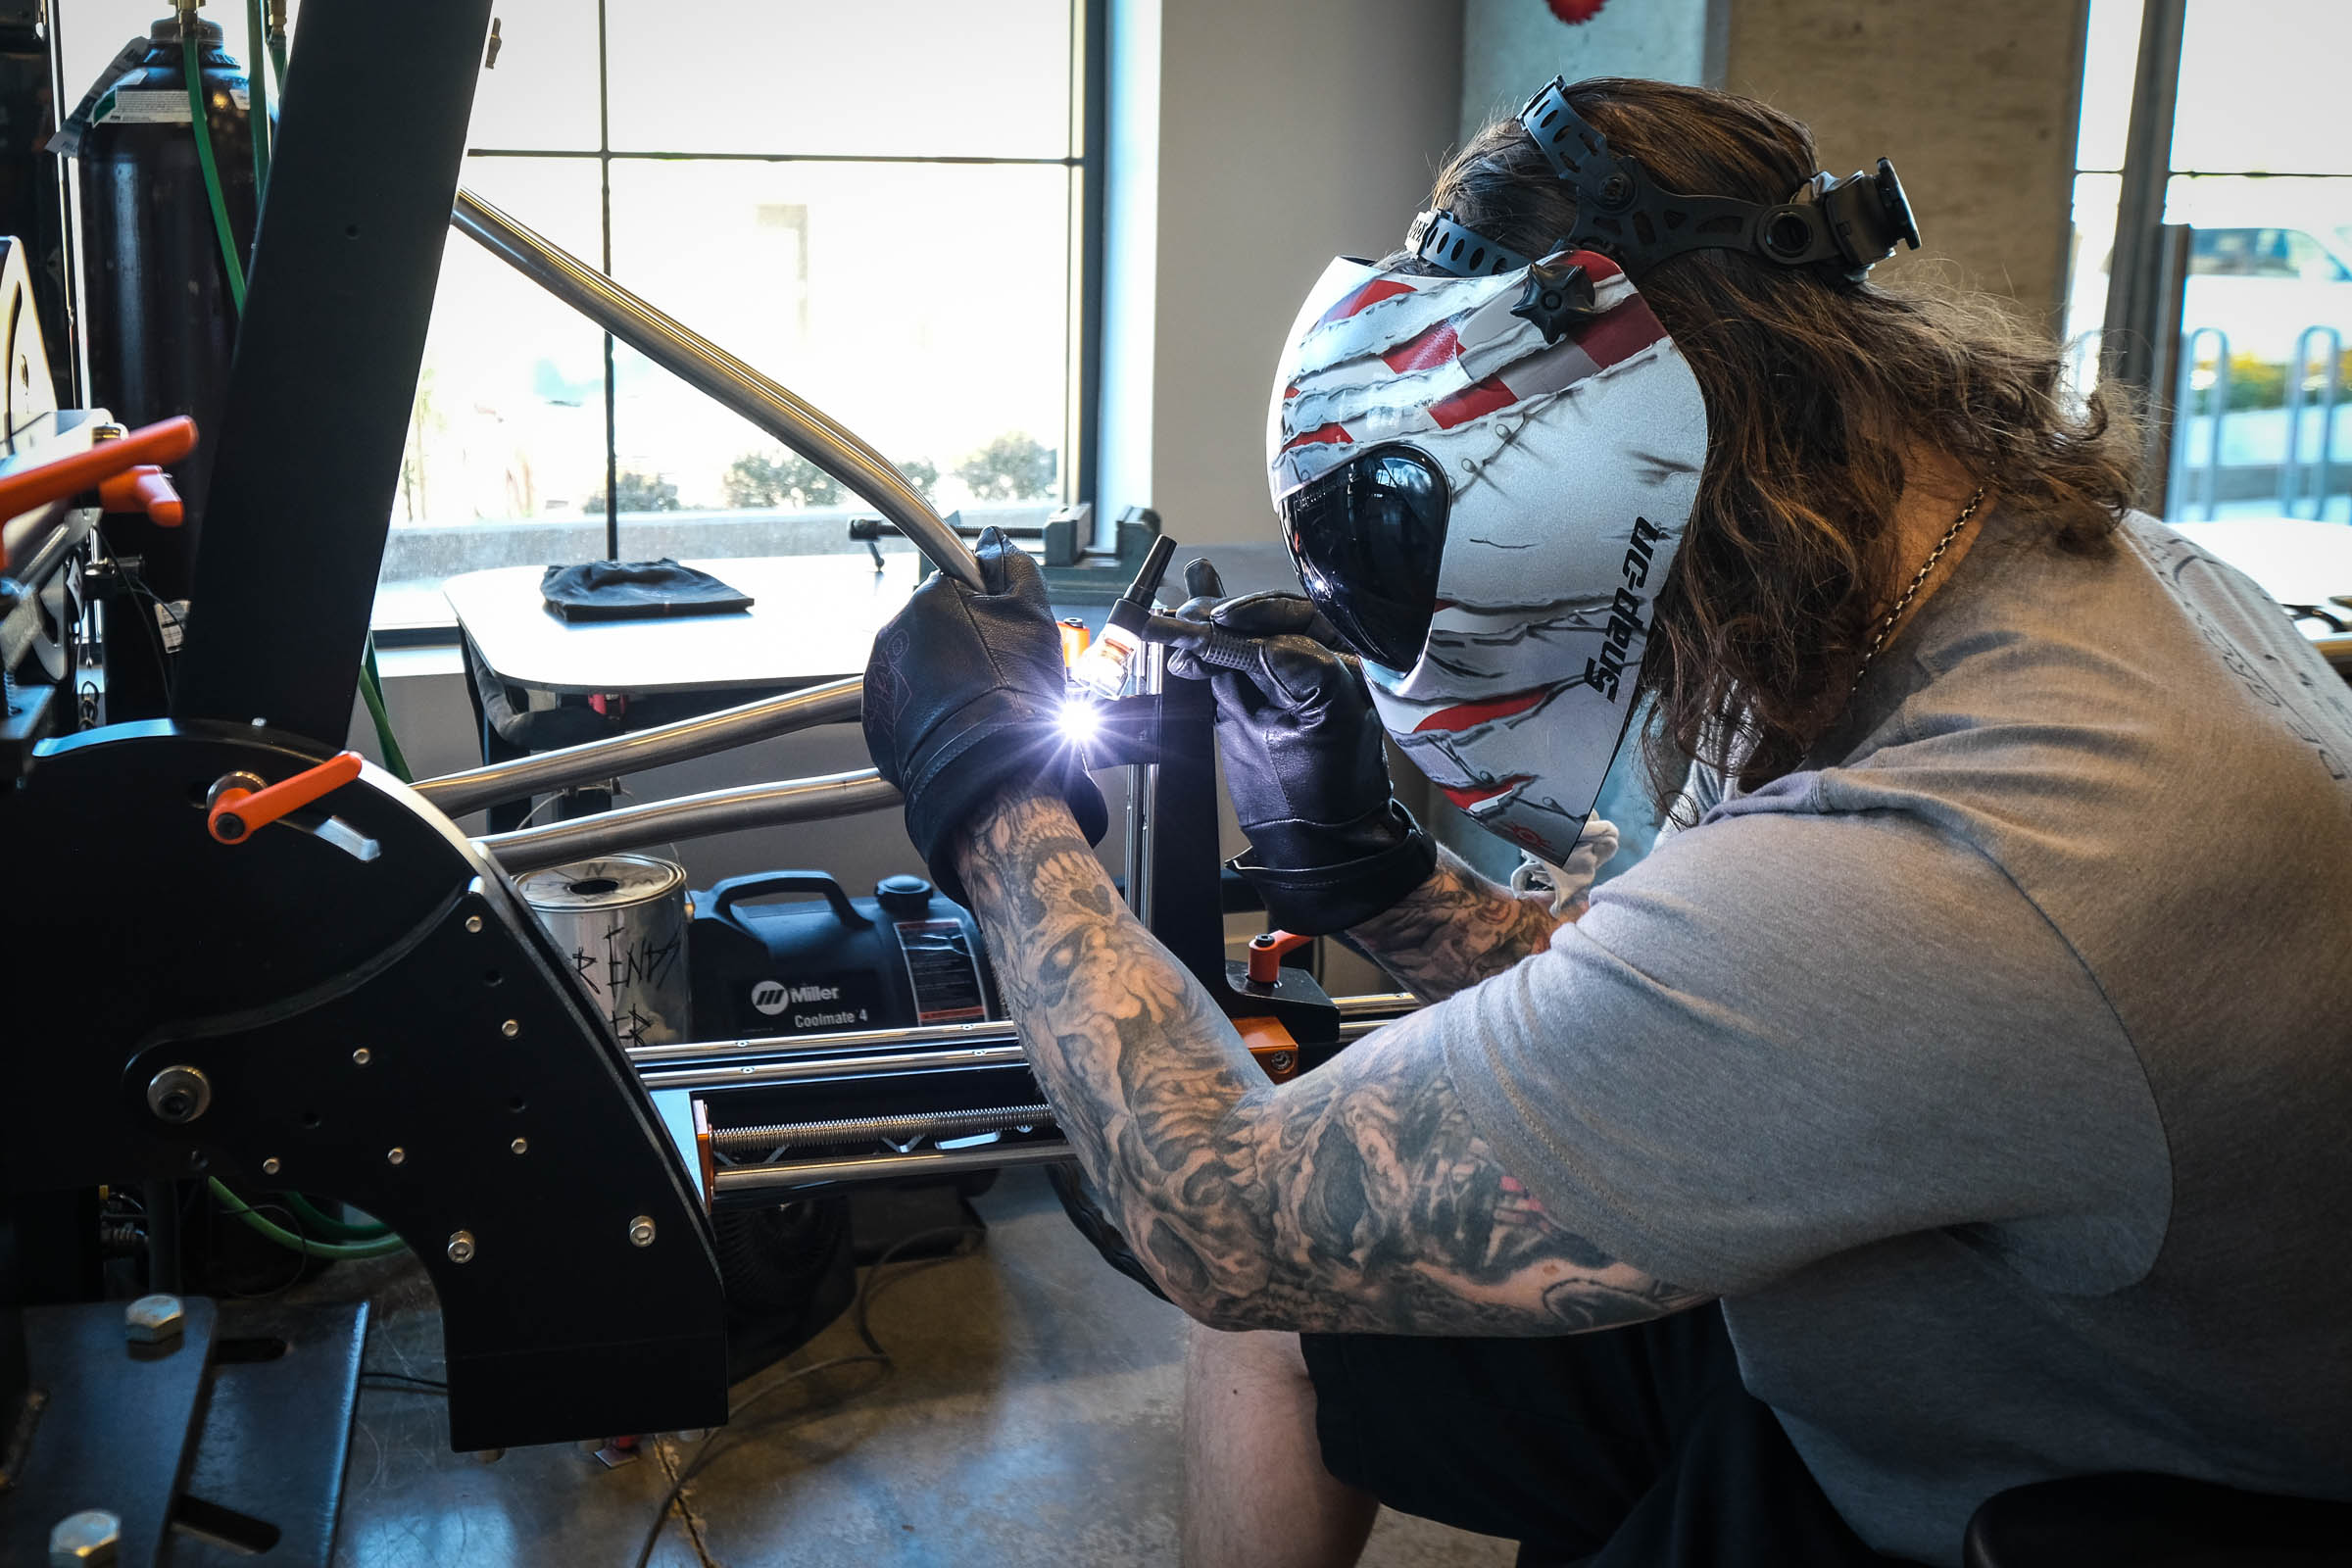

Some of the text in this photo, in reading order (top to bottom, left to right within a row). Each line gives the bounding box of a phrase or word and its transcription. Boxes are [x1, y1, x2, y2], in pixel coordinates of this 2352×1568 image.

[1584, 516, 1659, 704] Snap-on
[790, 985, 840, 1004] Miller
[794, 1008, 868, 1029] Coolmate 4
